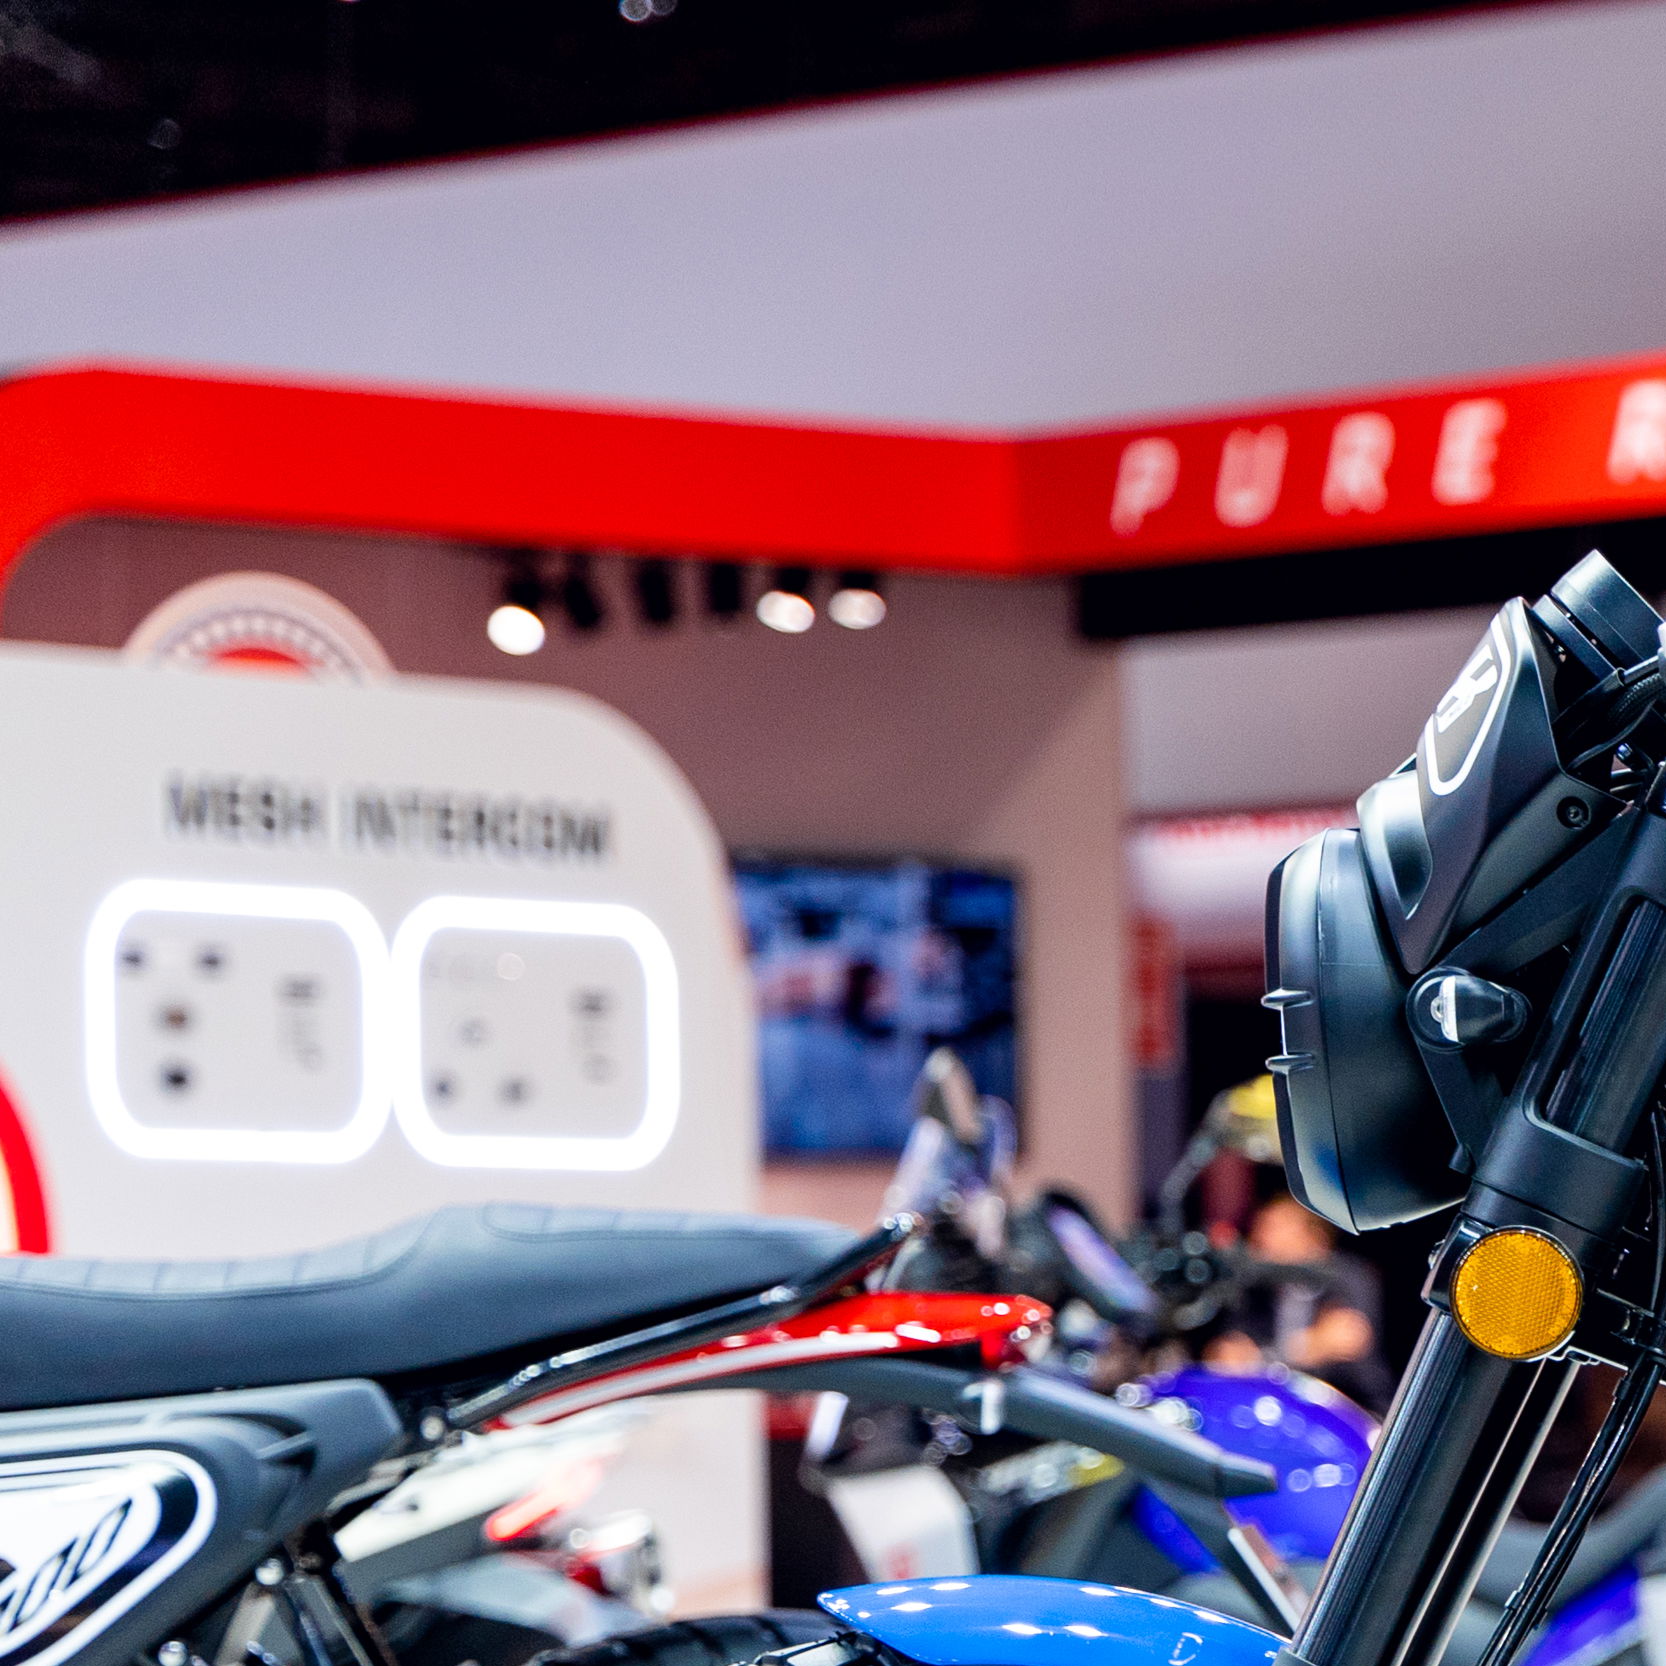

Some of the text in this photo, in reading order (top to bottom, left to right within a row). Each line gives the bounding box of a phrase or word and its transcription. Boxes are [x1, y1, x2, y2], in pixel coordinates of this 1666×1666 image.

[1108, 397, 1507, 537] PURE
[165, 770, 616, 864] MESH INTERCOM
